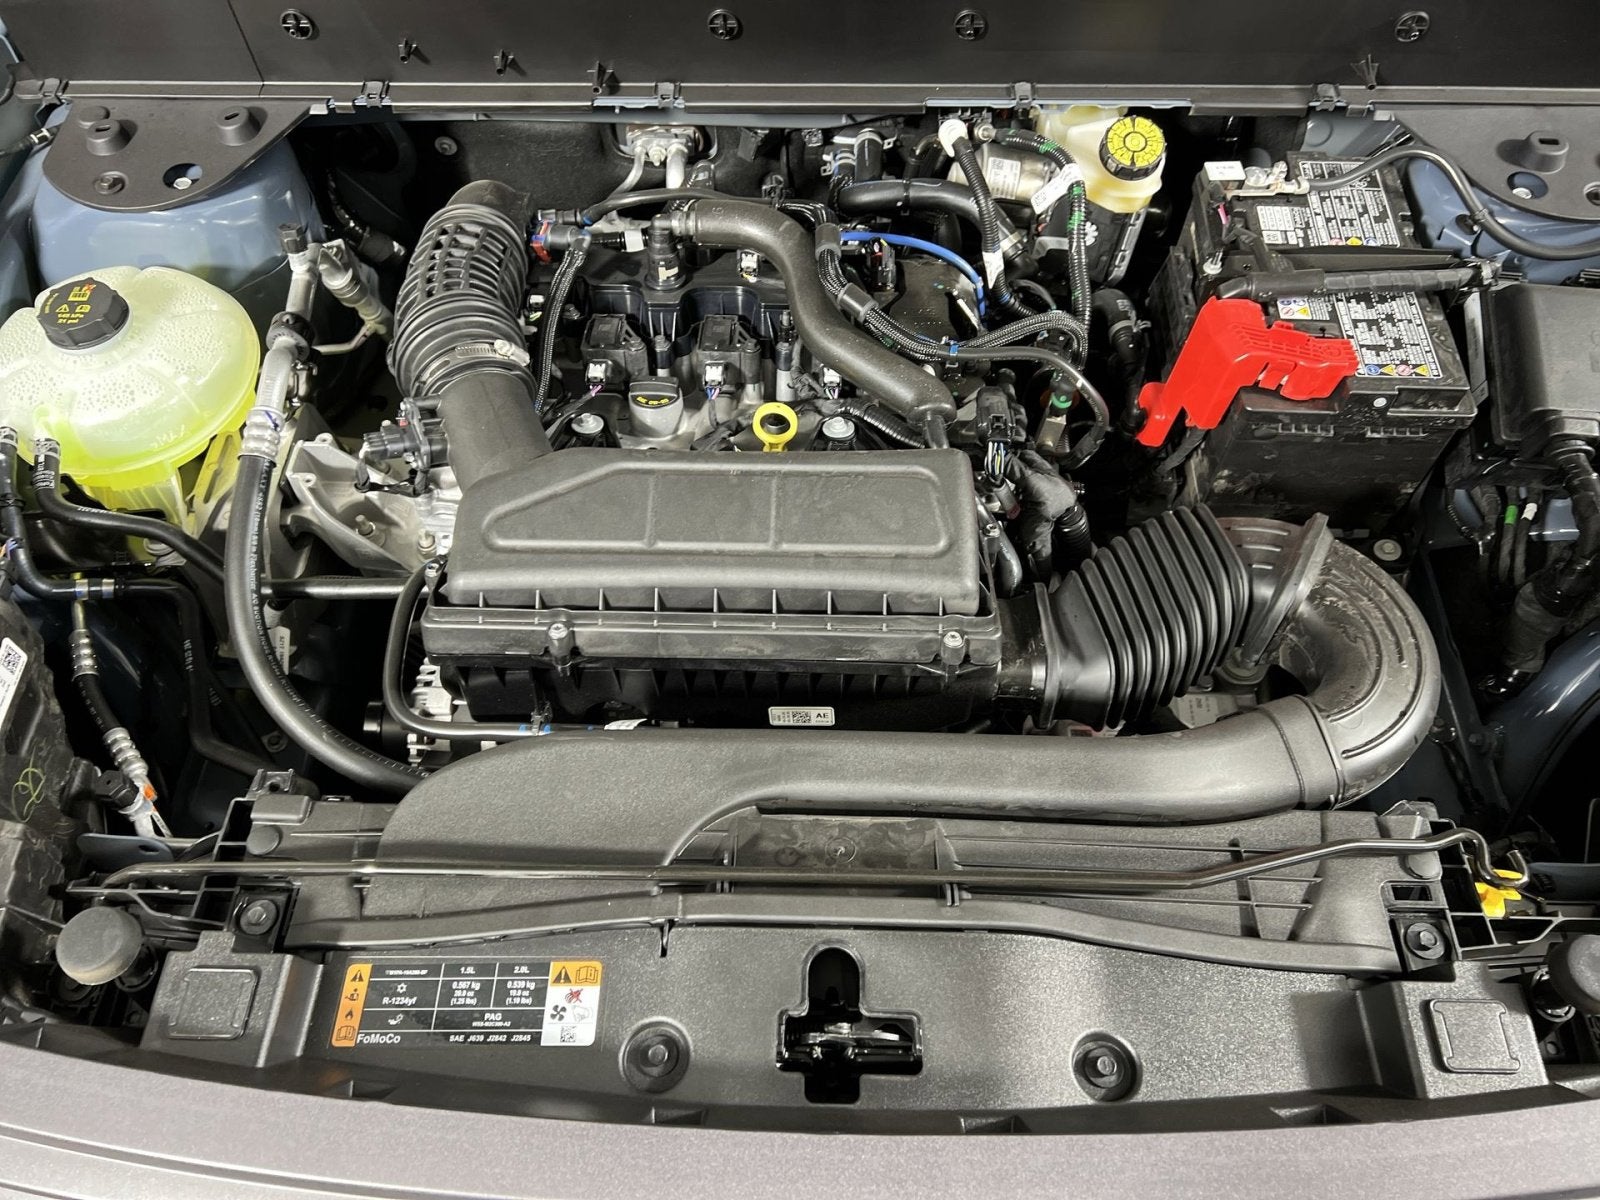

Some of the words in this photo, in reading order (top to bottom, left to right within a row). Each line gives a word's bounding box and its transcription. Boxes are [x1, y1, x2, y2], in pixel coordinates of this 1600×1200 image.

[460, 966, 476, 974] 1.5L
[513, 966, 530, 974] 2.0L
[470, 981, 481, 991] kg
[526, 980, 536, 991] kg
[382, 996, 418, 1007] R-1234yf
[484, 1012, 503, 1021] PAG
[357, 1033, 401, 1044] FoMoCo
[449, 1034, 465, 1042] SAE
[467, 1034, 485, 1042] J639
